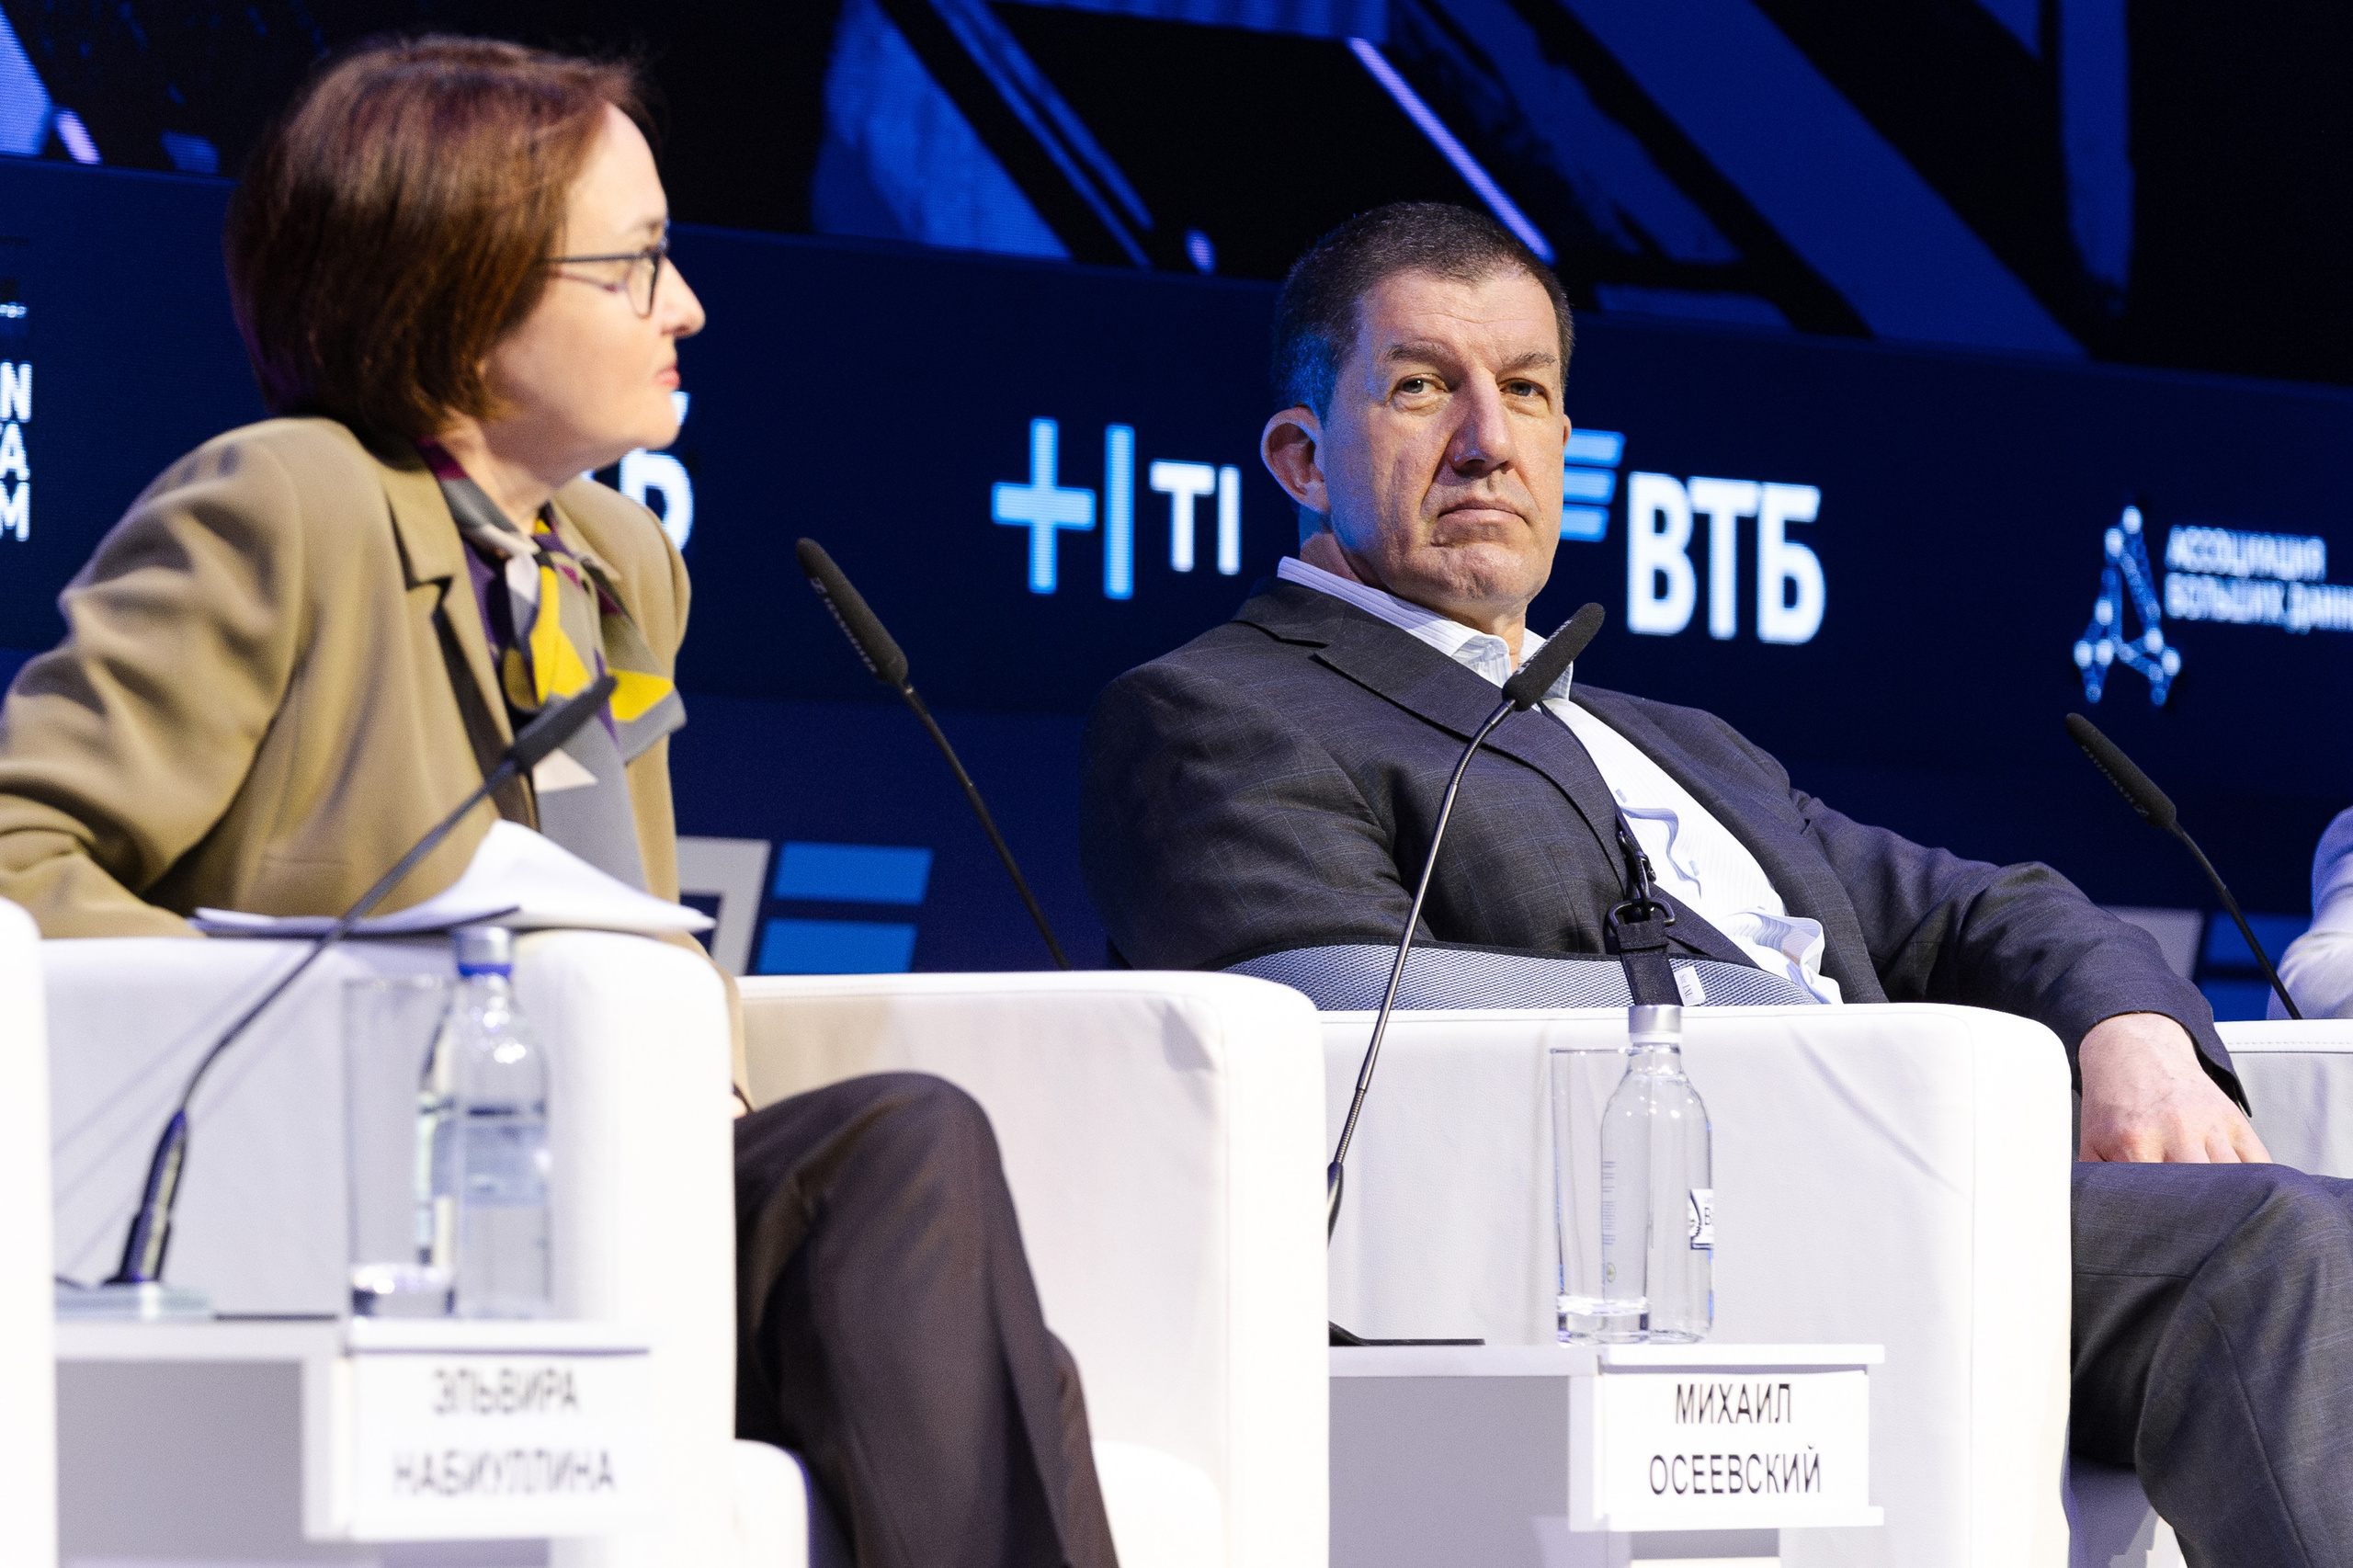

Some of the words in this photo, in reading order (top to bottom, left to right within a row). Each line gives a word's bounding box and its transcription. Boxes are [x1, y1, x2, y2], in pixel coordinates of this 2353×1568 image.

[1626, 471, 1827, 645] ВТБ
[2165, 525, 2327, 582] АССОЦИАЦИЯ
[2165, 572, 2285, 627] БОЛЬШИХ
[433, 1366, 578, 1415] ЭЛЬВИРА
[1676, 1383, 1791, 1424] МИХАИЛ
[392, 1448, 616, 1496] НАБИУЛЛИНА
[1649, 1443, 1822, 1495] ОСЕЕВСКИЙ
